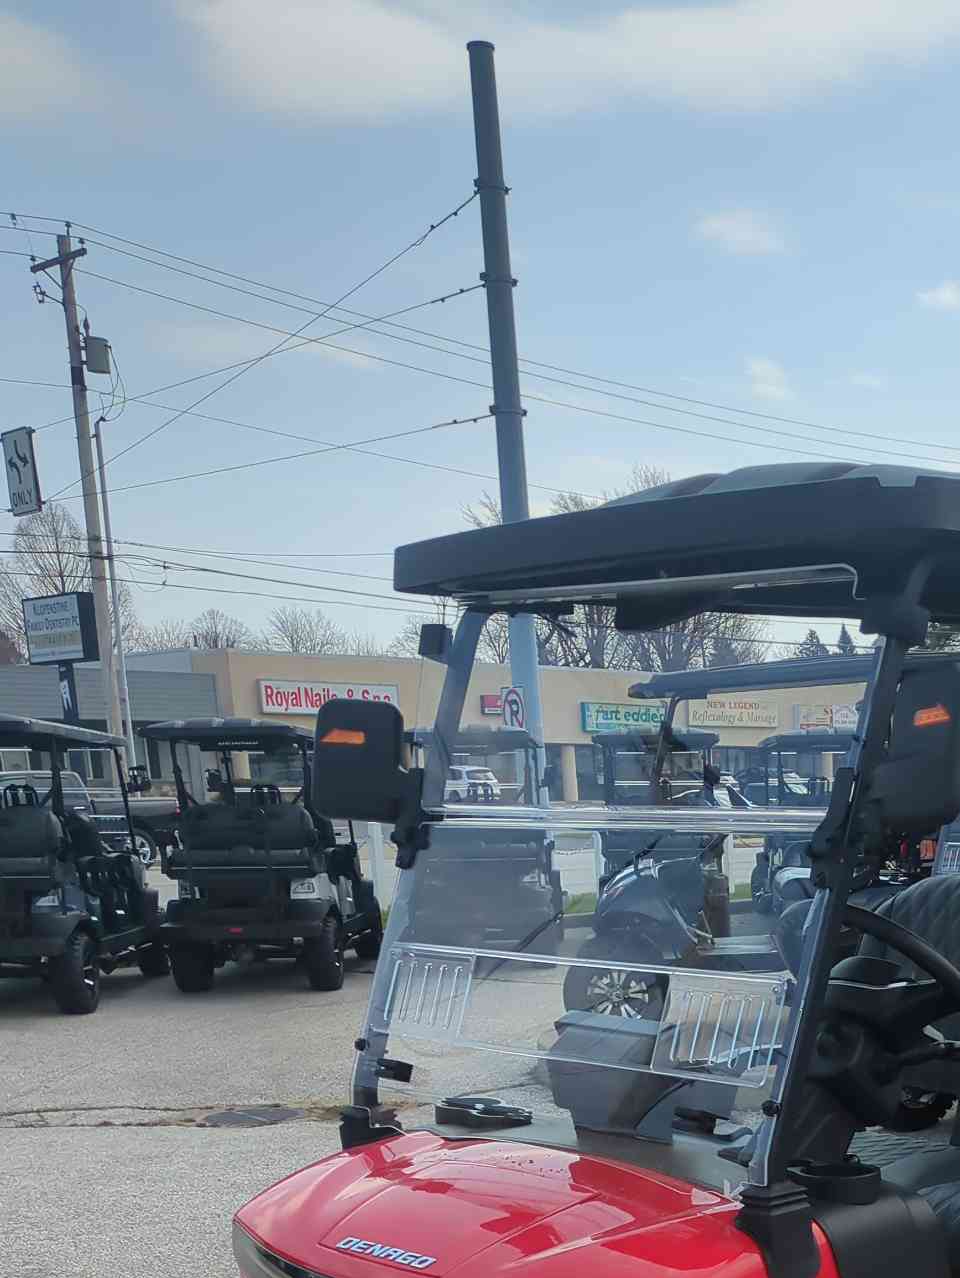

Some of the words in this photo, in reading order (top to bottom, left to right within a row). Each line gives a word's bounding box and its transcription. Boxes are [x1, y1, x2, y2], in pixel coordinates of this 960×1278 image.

[12, 487, 33, 507] ONLY
[264, 685, 302, 711] Royal
[692, 710, 736, 725] Reflexology
[336, 1236, 437, 1269] DENAGO
